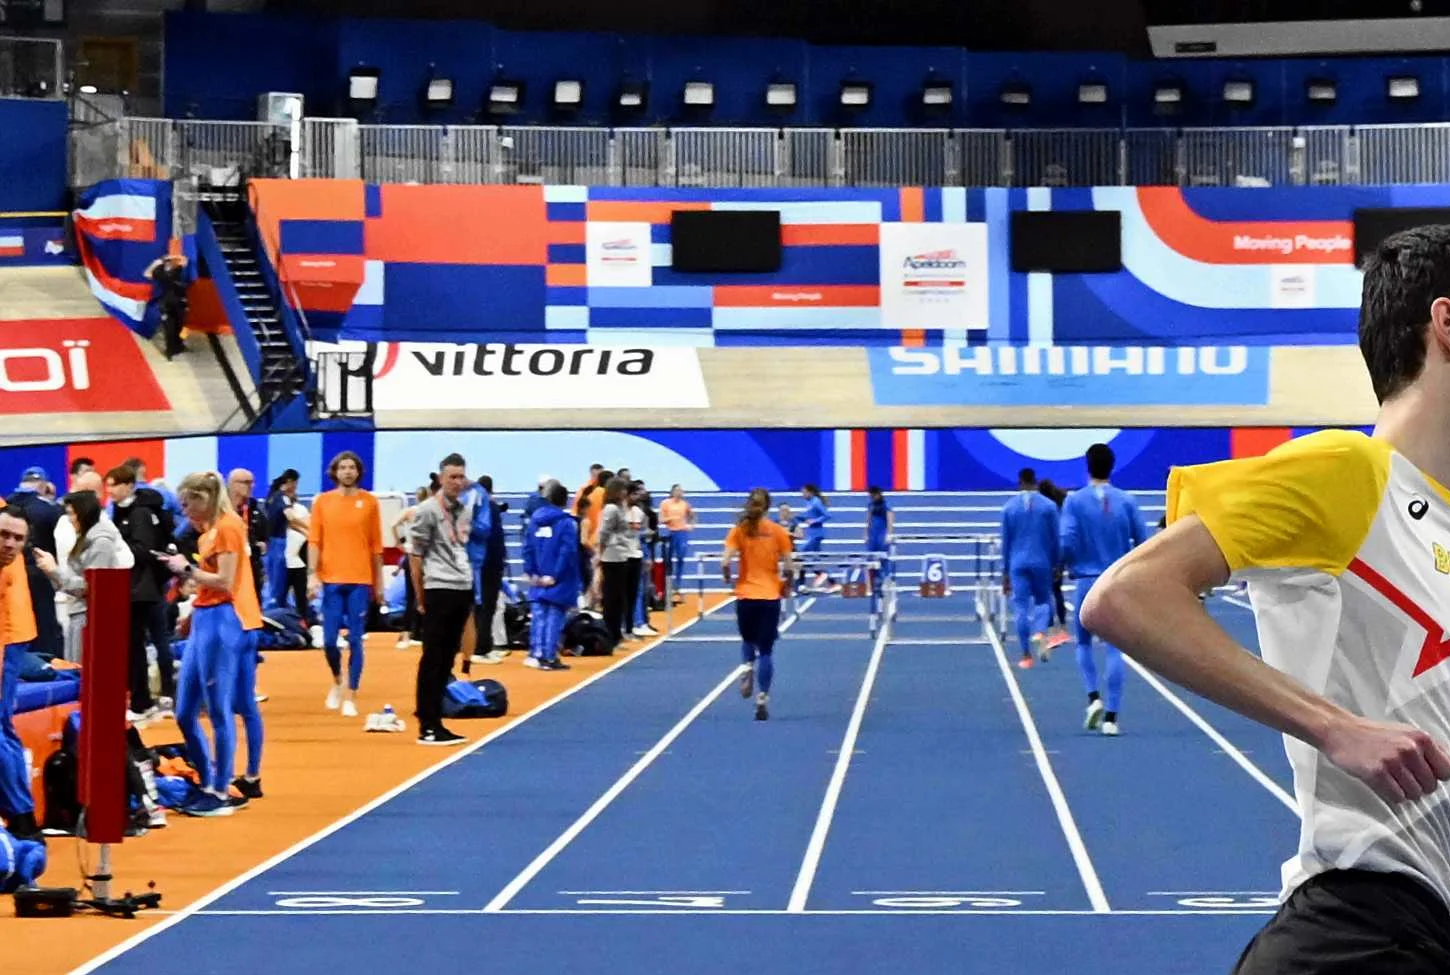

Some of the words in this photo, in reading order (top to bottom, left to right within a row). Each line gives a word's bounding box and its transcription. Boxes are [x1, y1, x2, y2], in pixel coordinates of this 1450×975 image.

[1233, 235, 1293, 255] Moving
[1295, 234, 1352, 253] People
[887, 345, 1249, 376] SHIMANO
[927, 562, 943, 582] 6
[275, 896, 427, 907] 8
